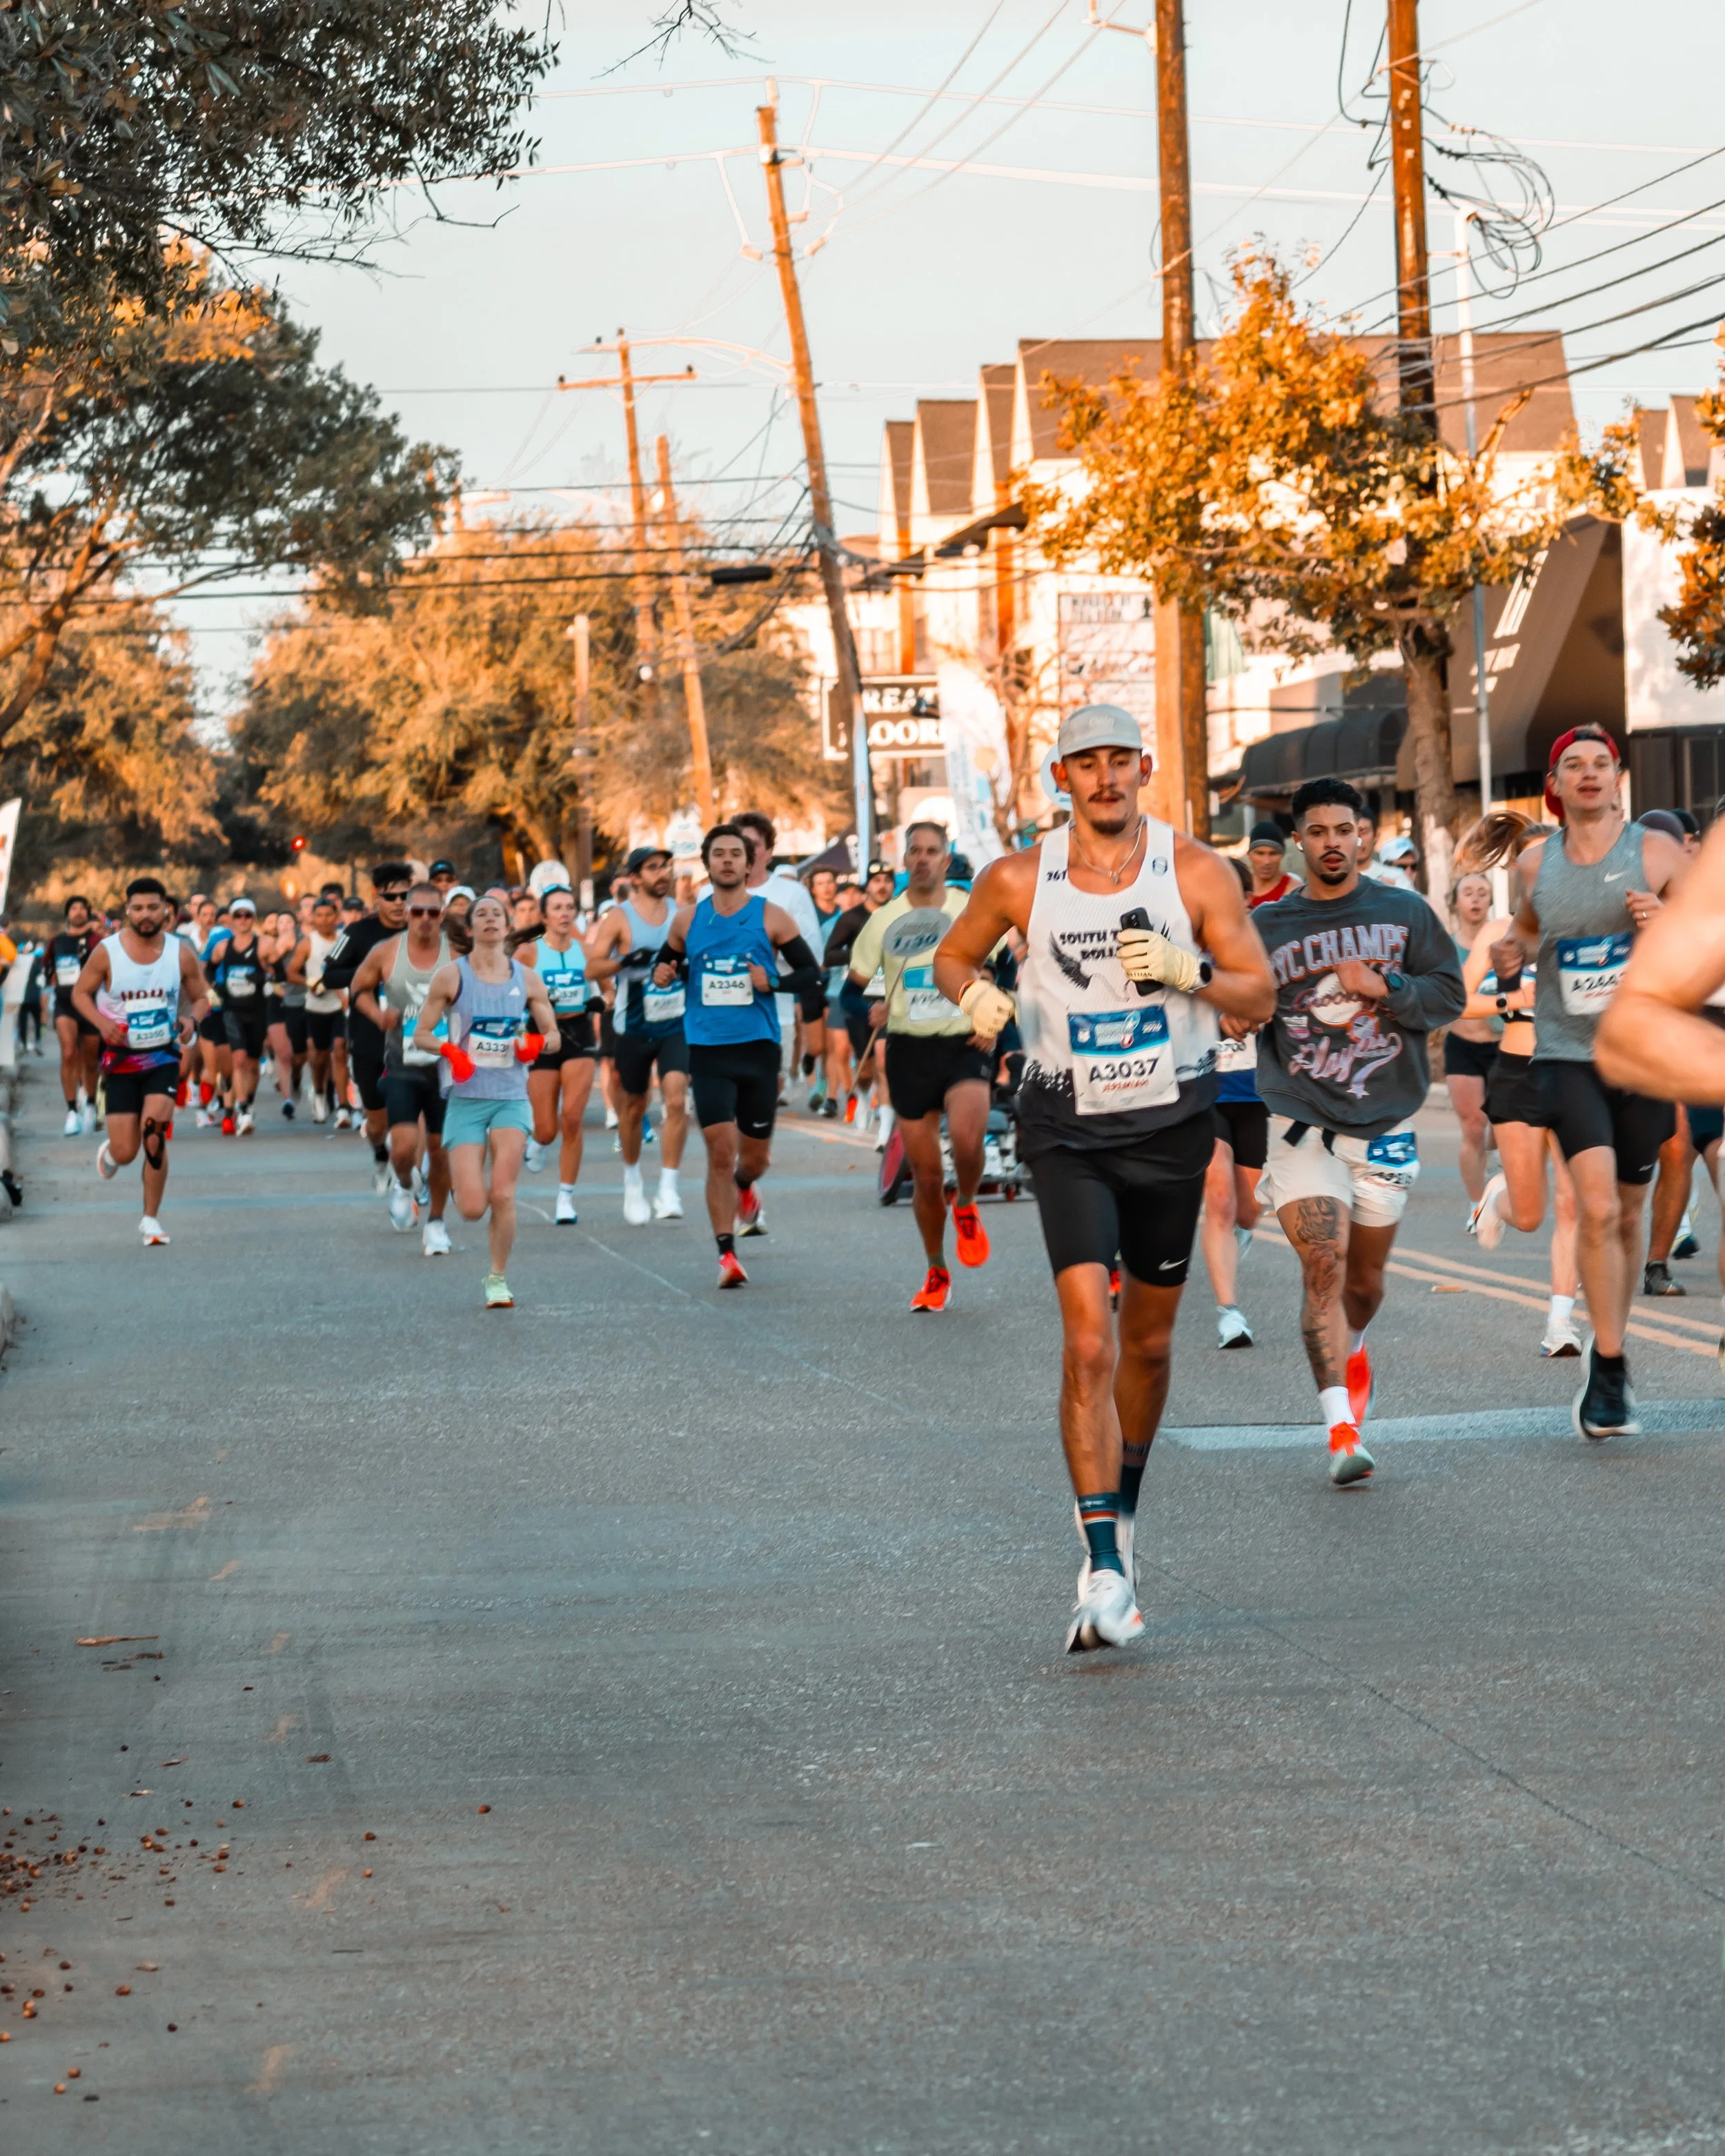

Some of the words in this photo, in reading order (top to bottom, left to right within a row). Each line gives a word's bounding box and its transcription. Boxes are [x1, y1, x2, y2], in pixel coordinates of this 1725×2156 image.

[1303, 924, 1409, 973] CHAMPS
[709, 980, 746, 989] A2346
[1089, 1056, 1160, 1084] A3037
